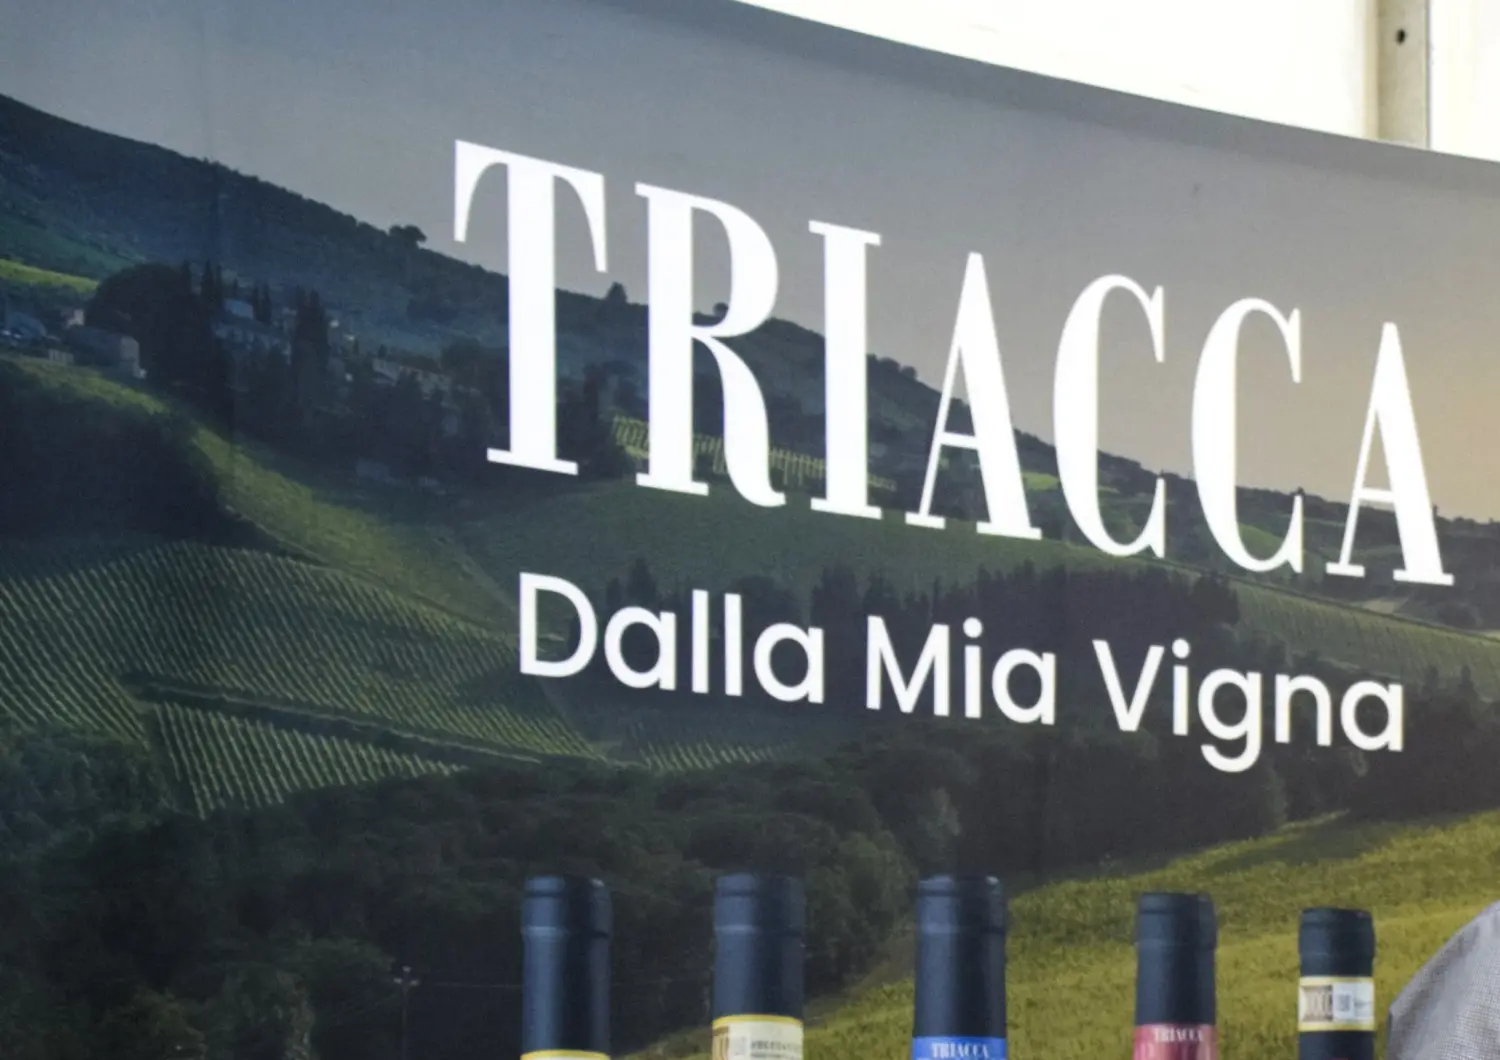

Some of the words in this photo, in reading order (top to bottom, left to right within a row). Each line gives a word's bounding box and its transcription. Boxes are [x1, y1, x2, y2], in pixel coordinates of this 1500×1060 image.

[455, 139, 1453, 587] TRIACCA
[518, 571, 825, 704] Dalla
[865, 615, 1056, 726] Mia
[1092, 638, 1404, 773] Vigna
[931, 1042, 989, 1059] TRIACCA
